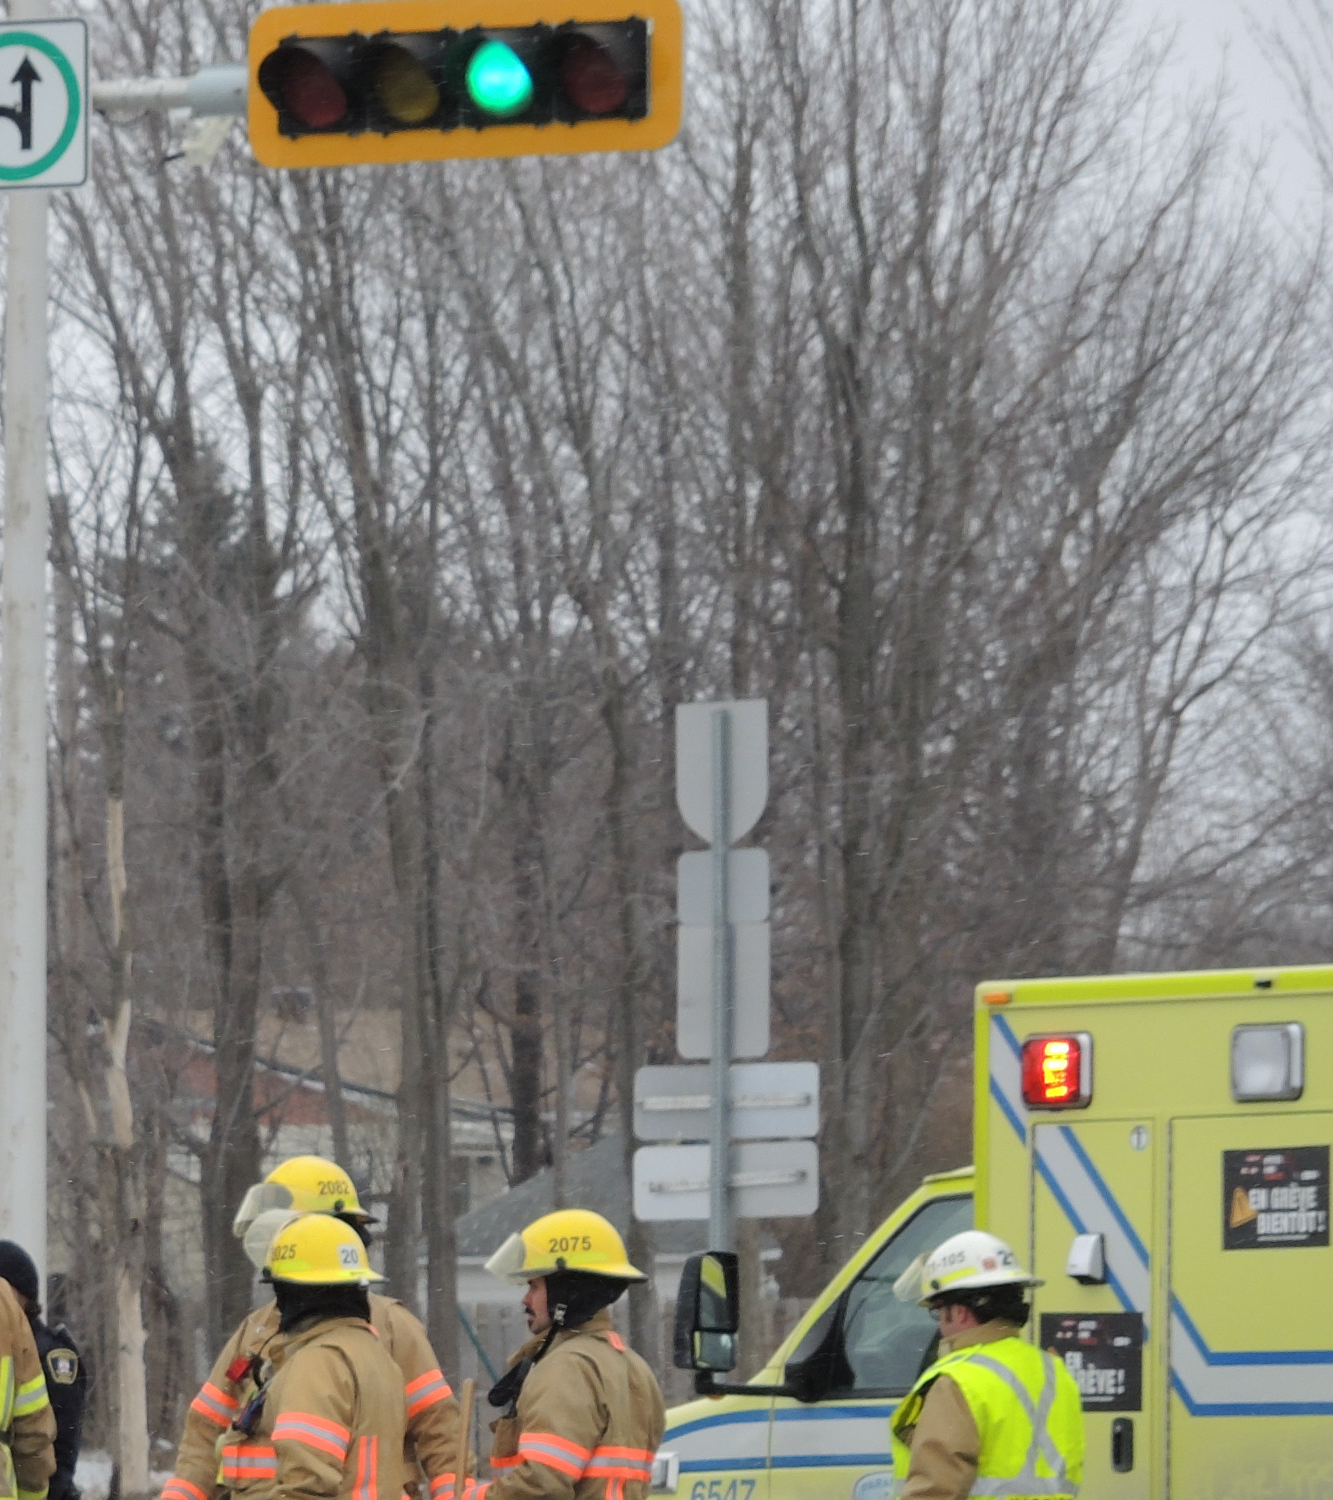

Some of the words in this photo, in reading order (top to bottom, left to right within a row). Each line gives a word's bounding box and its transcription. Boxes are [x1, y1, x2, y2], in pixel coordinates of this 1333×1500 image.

[317, 1181, 350, 1196] 2082
[1248, 1187, 1269, 1210] EN
[1270, 1182, 1318, 1210] GRÈVE
[549, 1236, 592, 1254] 2075
[340, 1248, 359, 1265] 20
[1071, 1363, 1125, 1395] RÈVE!
